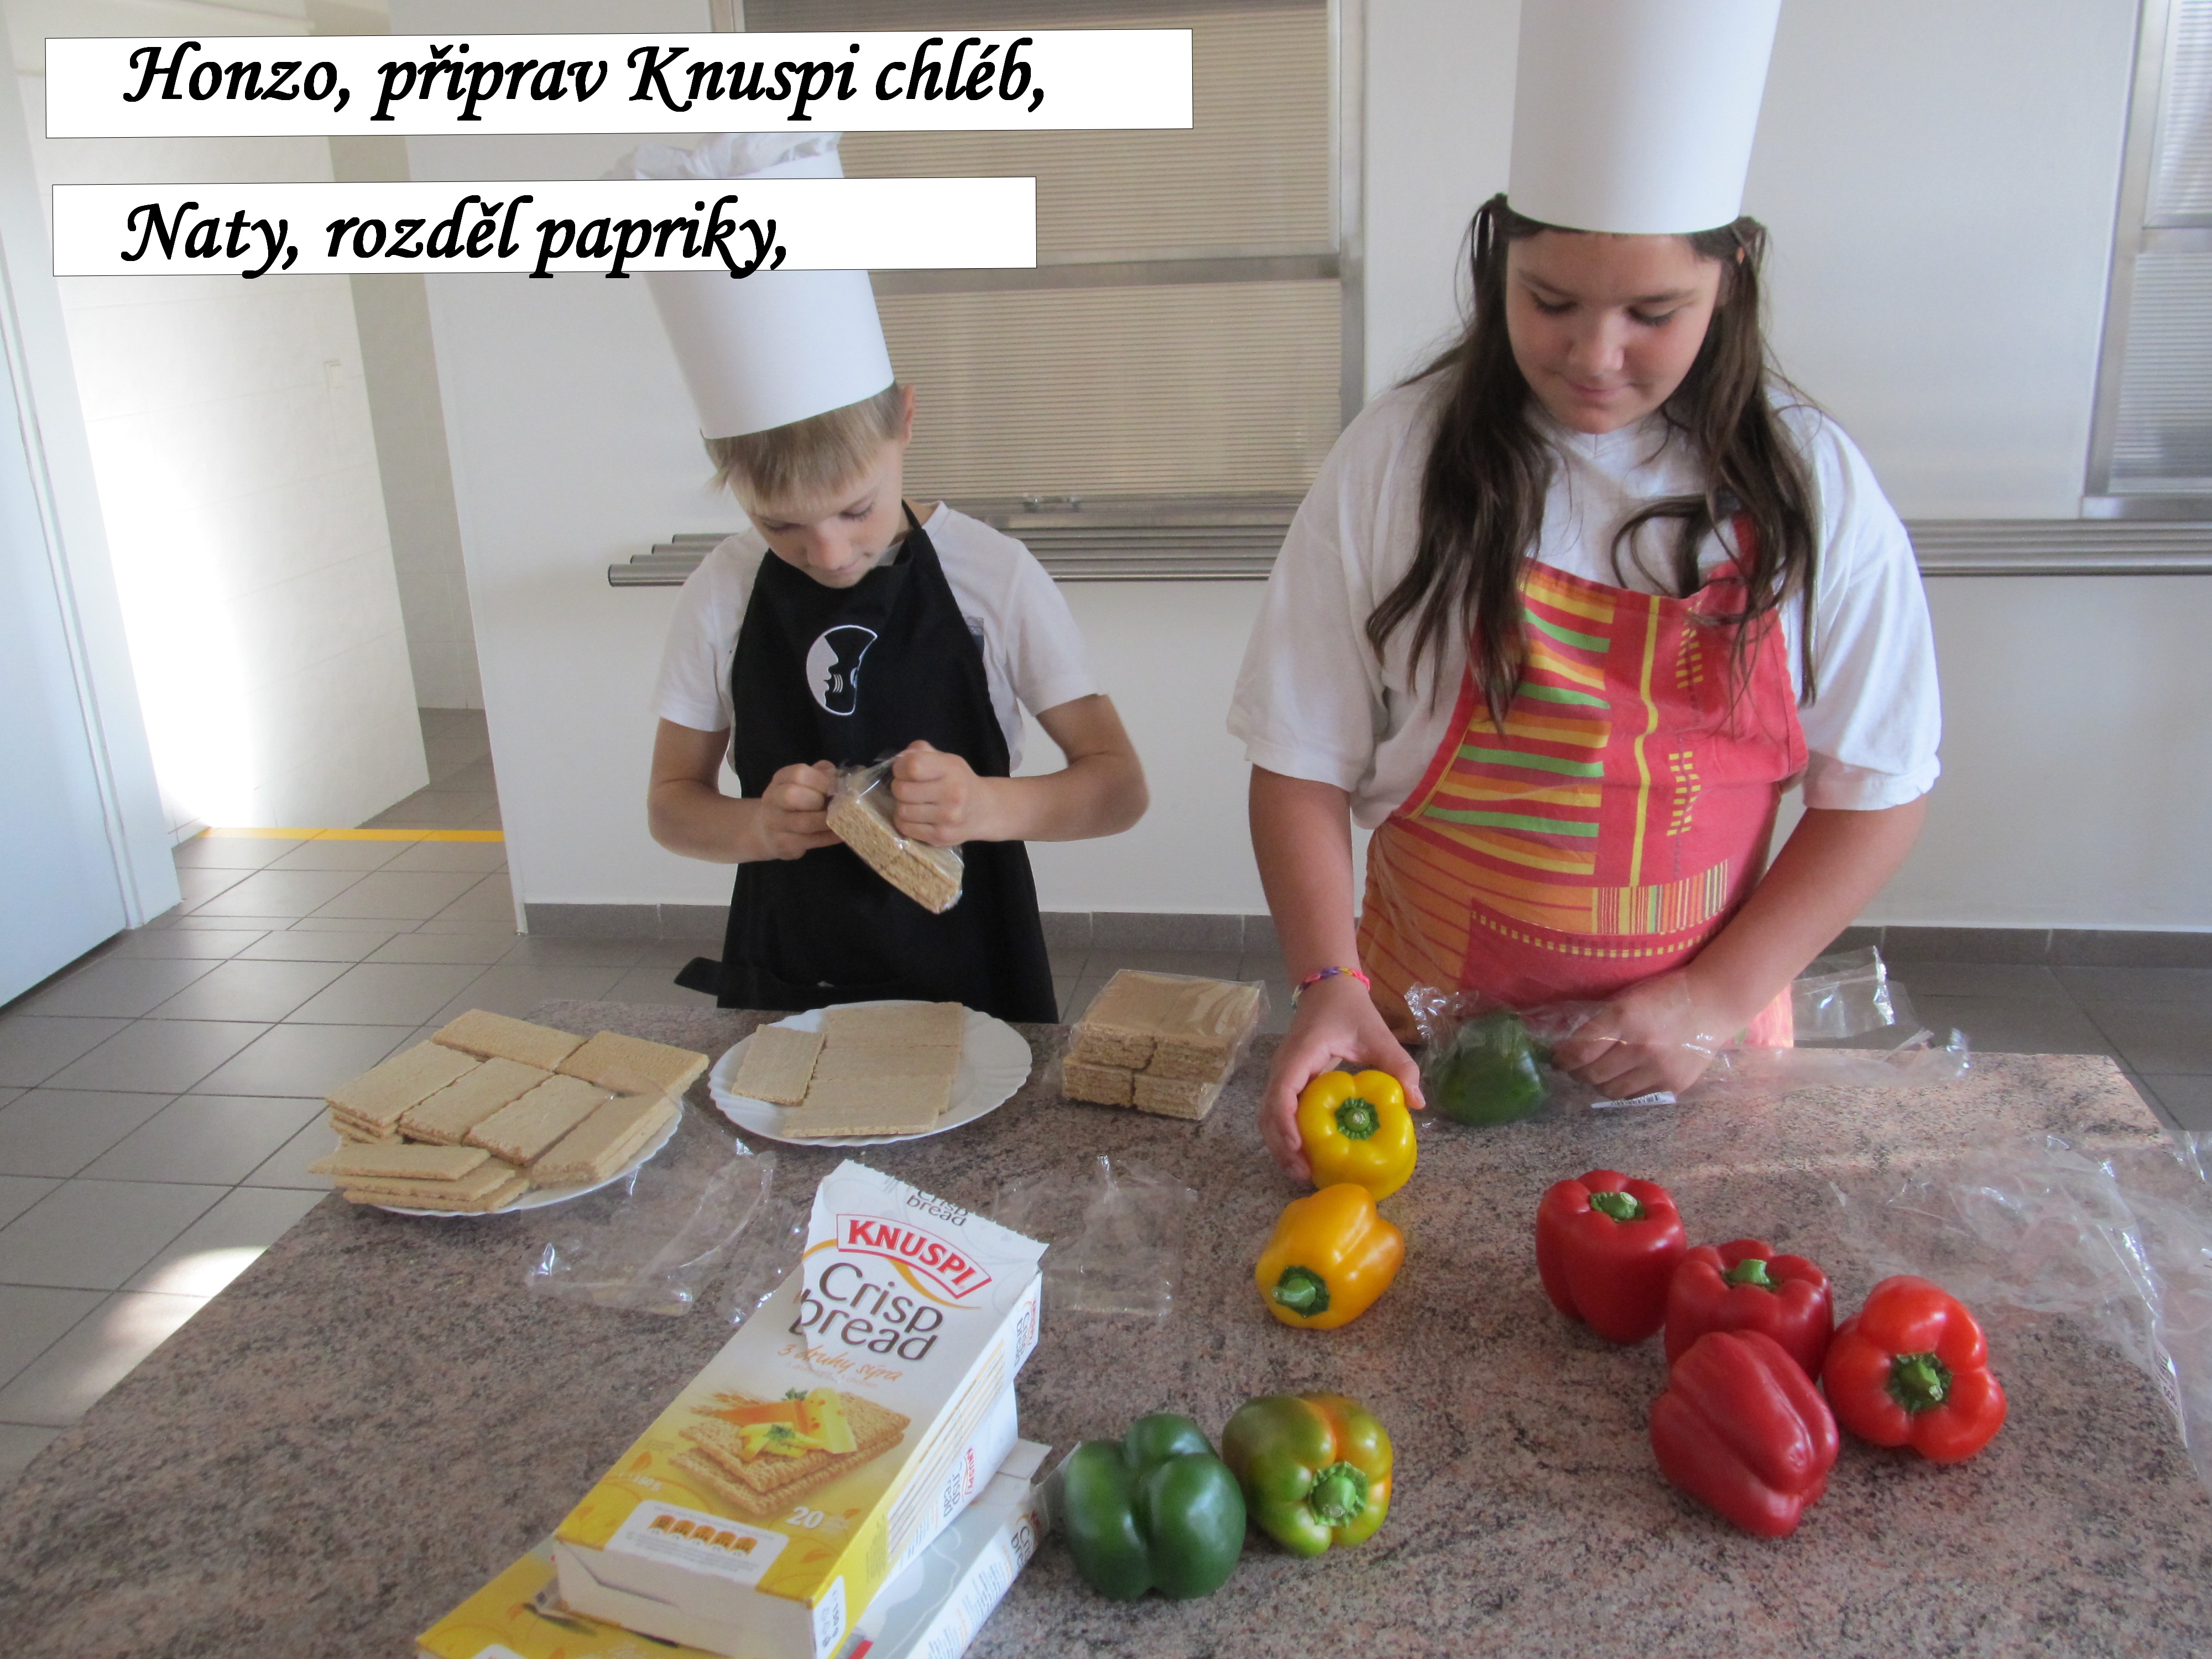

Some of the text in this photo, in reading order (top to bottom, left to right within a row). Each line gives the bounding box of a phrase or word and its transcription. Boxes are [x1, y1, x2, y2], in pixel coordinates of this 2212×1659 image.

[906, 1194, 967, 1226] bread
[847, 1219, 981, 1287] KNUSPI
[788, 1288, 938, 1361] bread
[818, 1262, 943, 1333] Crisp
[785, 1506, 825, 1529] 20
